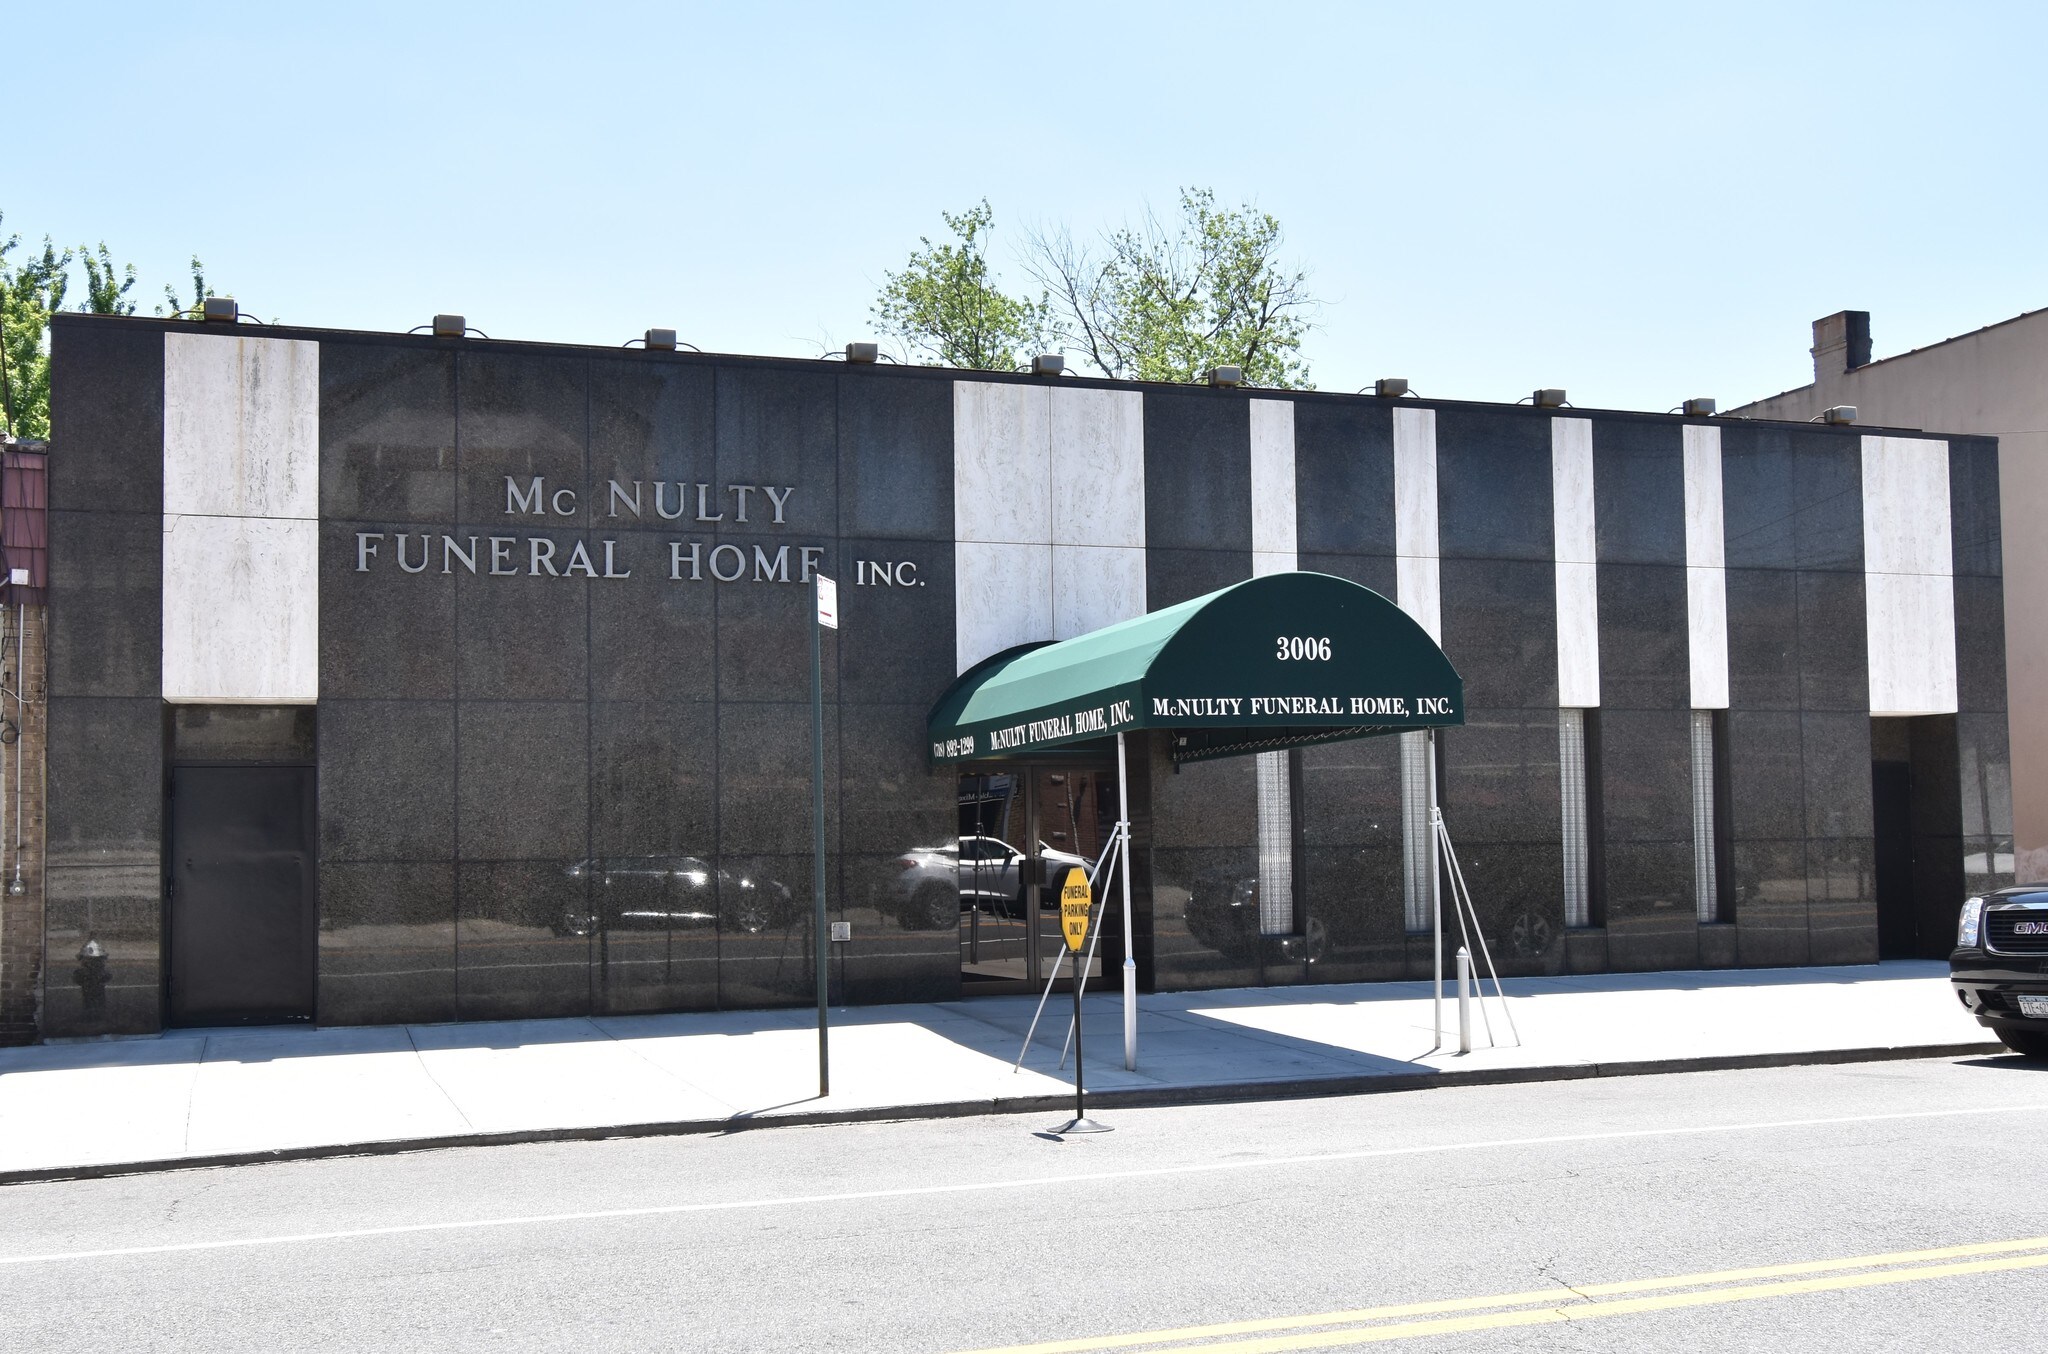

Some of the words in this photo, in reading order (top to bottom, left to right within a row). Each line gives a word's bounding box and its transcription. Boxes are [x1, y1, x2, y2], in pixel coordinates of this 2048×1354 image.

[504, 475, 577, 516] Mc
[606, 479, 796, 524] NULTY
[355, 532, 632, 578] FUNERAL
[855, 560, 926, 587] INC.
[1276, 636, 1332, 661] 3006
[1152, 697, 1243, 717] McNULTY
[1250, 696, 1344, 716] FUNERAL
[1350, 697, 1410, 718] HOME,
[1416, 697, 1454, 715] INC.
[990, 724, 1027, 751] McNULTY
[1028, 715, 1073, 742] FUNERAL
[1075, 707, 1108, 734] HOME,
[1109, 699, 1134, 727] INC.
[946, 735, 975, 758] 892-1299
[1064, 885, 1088, 899] FUNERAL
[1064, 903, 1088, 917] PARKING
[1069, 922, 1083, 936] ONLY
